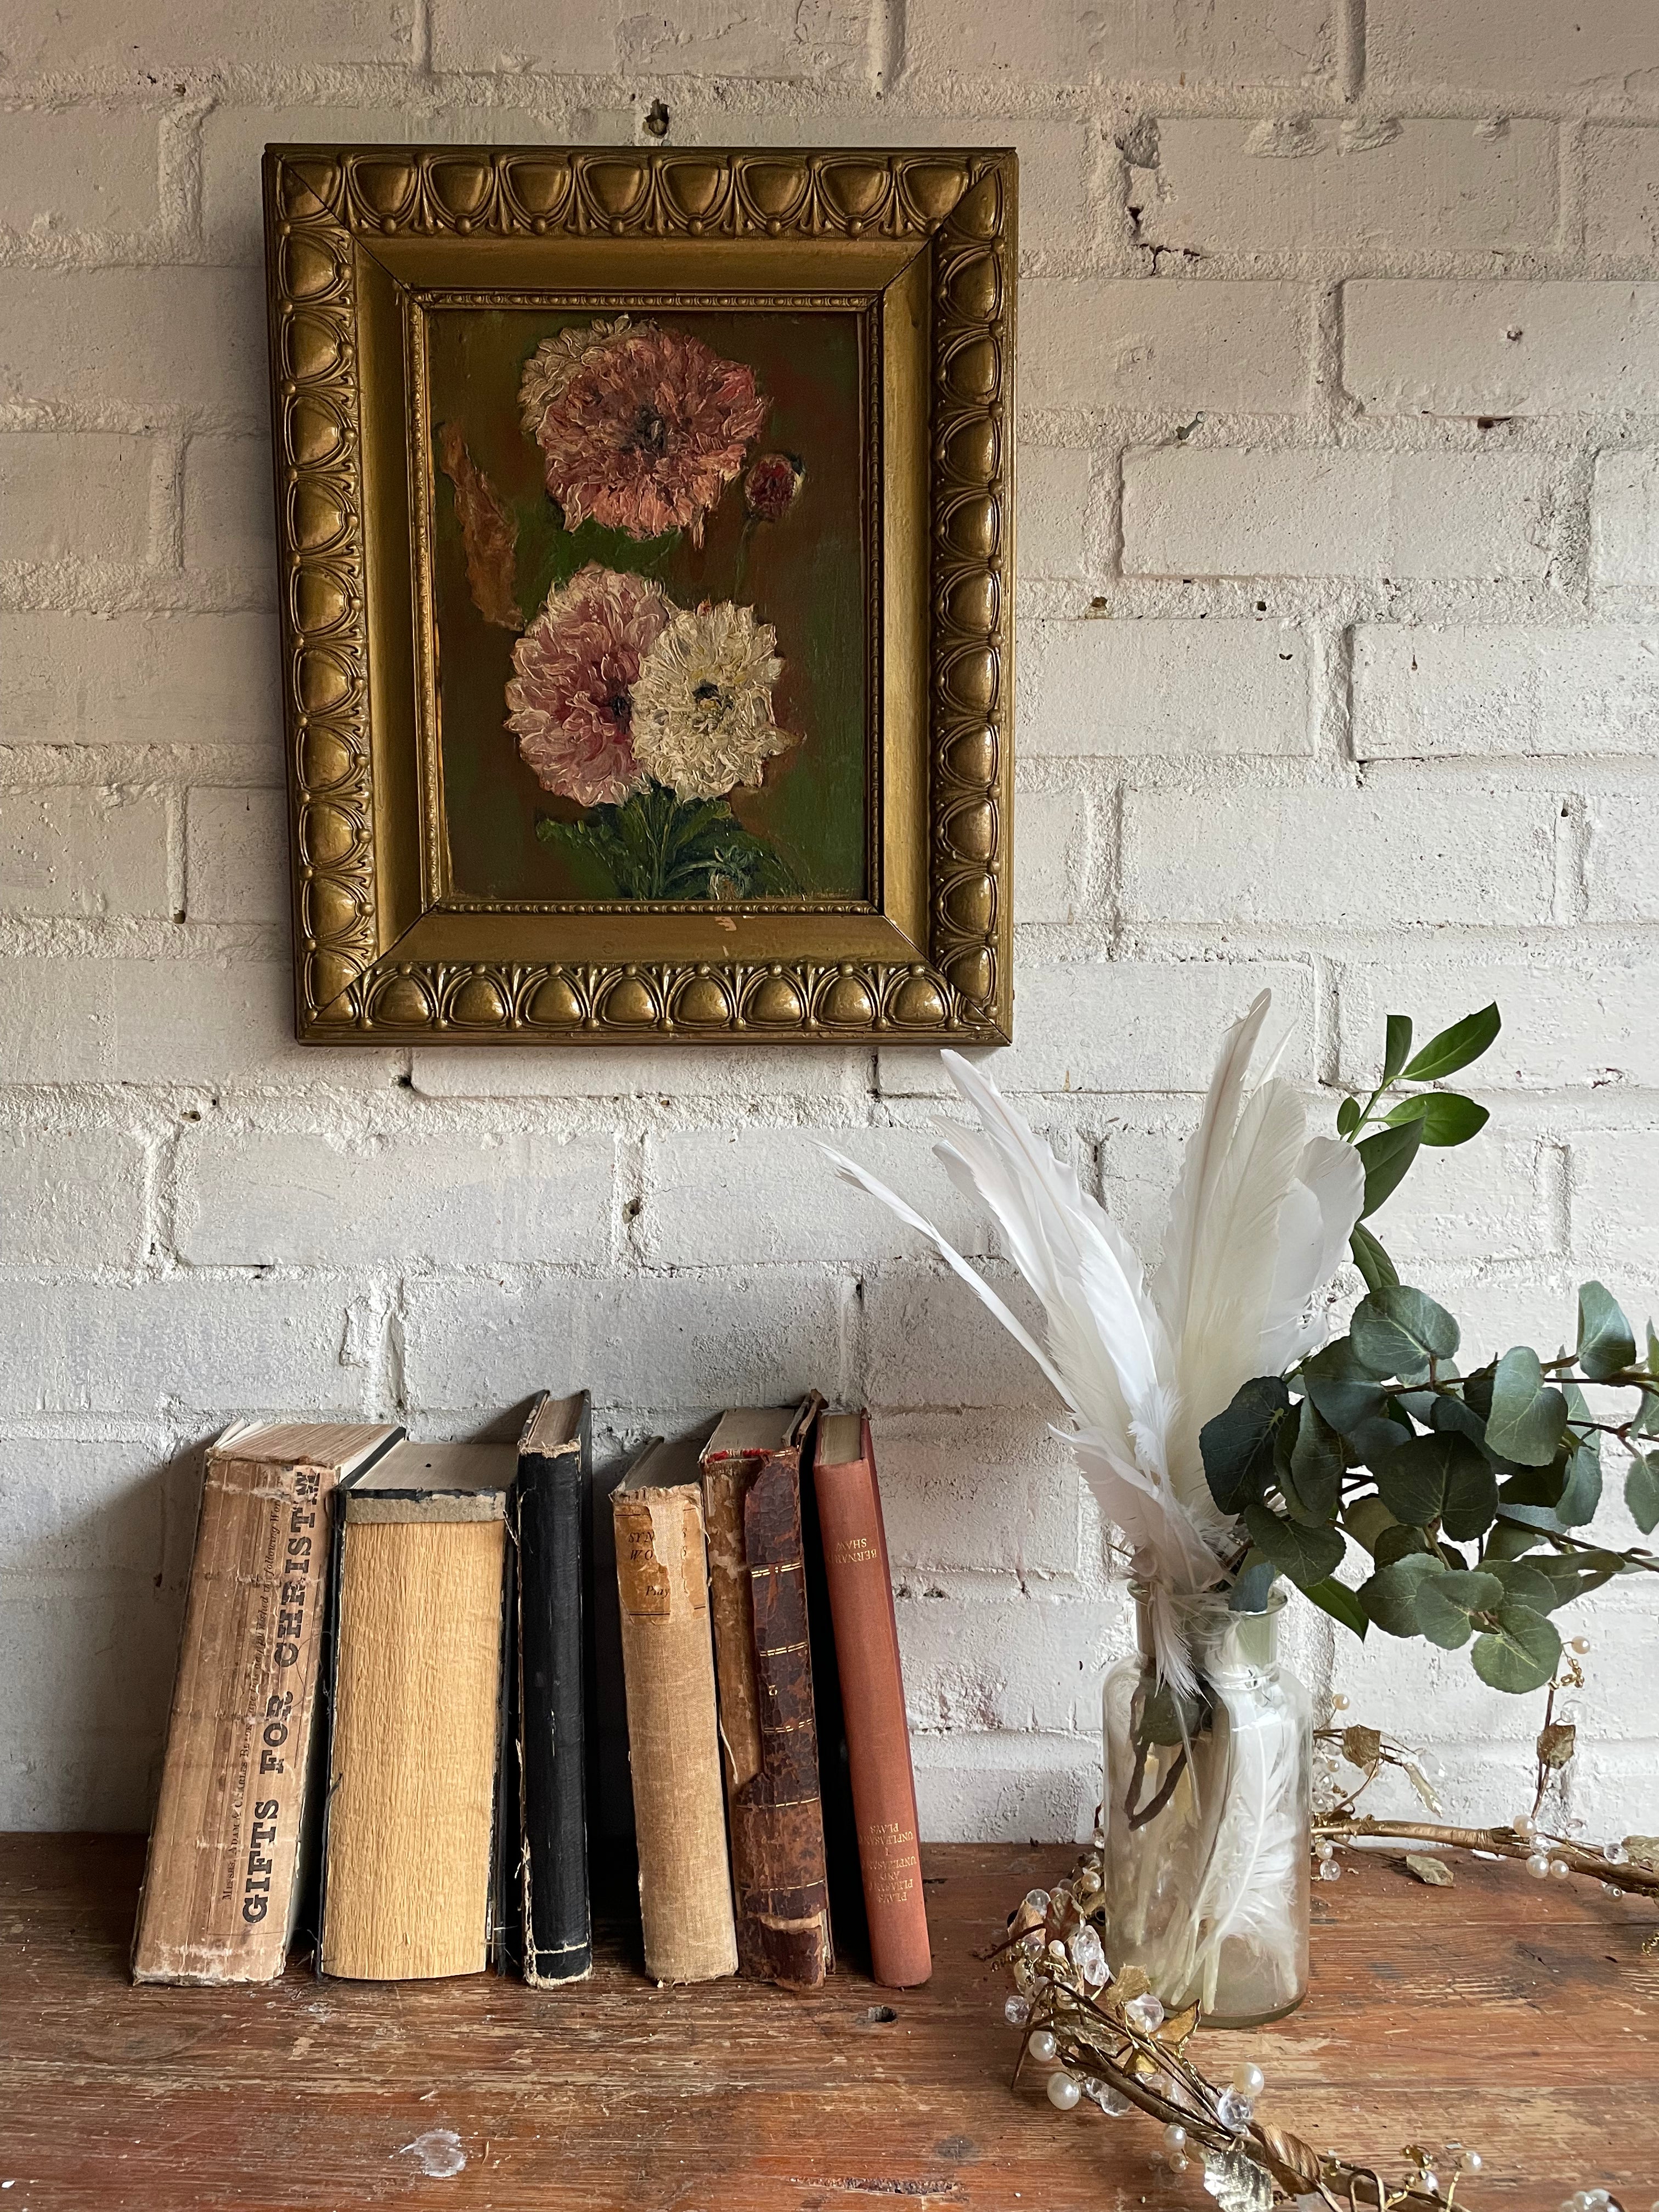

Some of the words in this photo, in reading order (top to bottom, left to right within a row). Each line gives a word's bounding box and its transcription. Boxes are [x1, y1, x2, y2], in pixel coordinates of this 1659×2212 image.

[835, 1538, 867, 1552] SHAW
[827, 1549, 877, 1564] BERNARD
[234, 1762, 247, 1808] CRLES
[263, 1526, 280, 1576] following
[259, 1691, 293, 1774] FOR
[870, 1822, 899, 1834] PLAYS
[242, 1800, 279, 1923] GIFTS
[862, 1856, 917, 1870] UNPLEASAN
